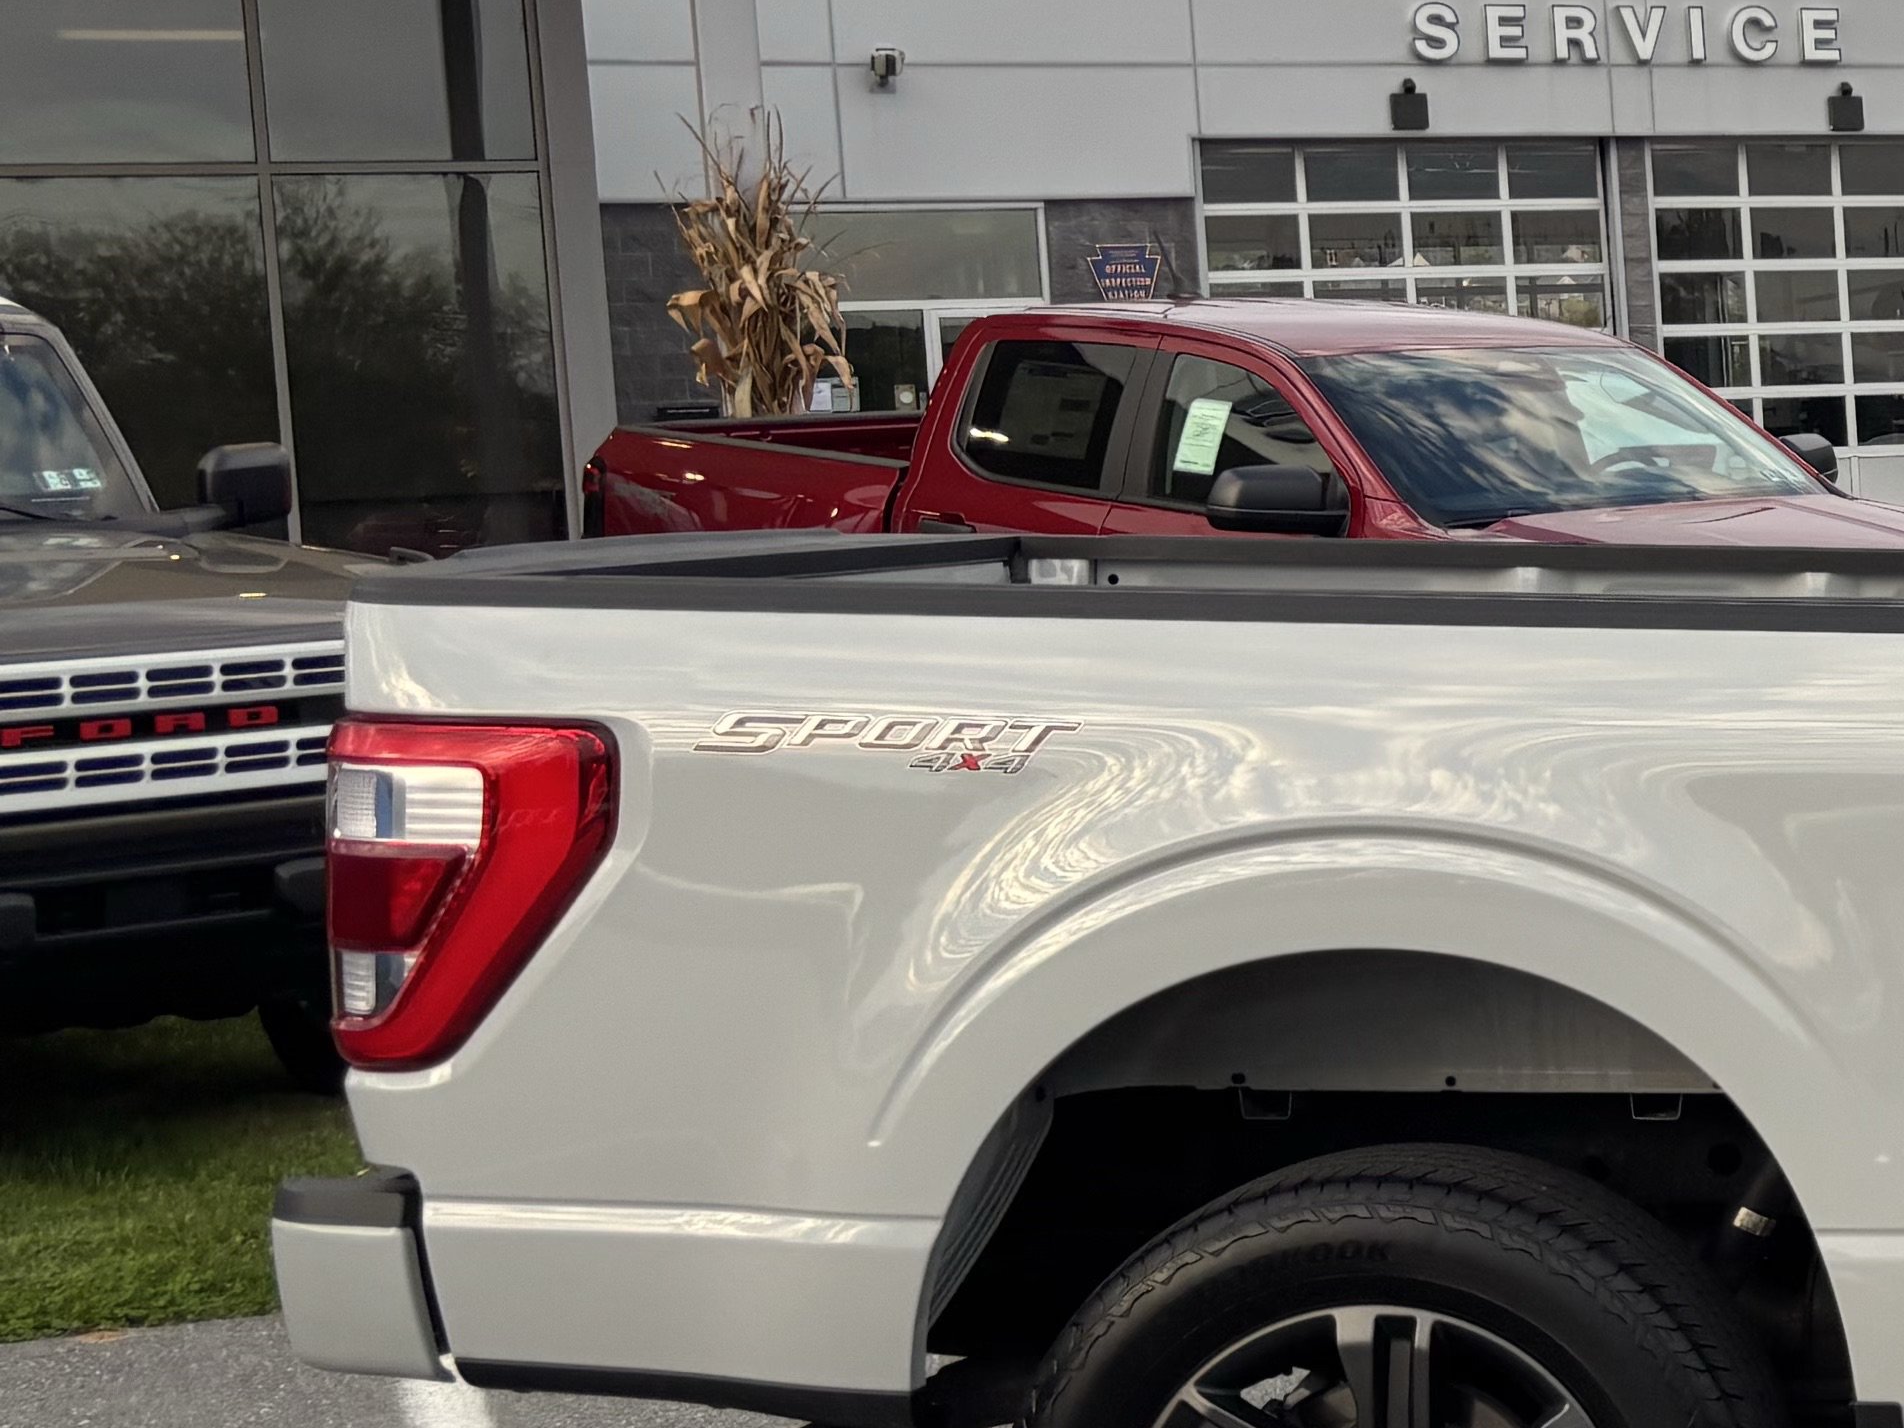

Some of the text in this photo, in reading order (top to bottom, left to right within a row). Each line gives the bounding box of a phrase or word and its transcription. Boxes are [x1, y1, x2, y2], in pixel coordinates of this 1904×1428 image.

[1413, 2, 1843, 64] SERVICE
[1, 705, 279, 748] FORD
[691, 709, 1084, 755] SPORT
